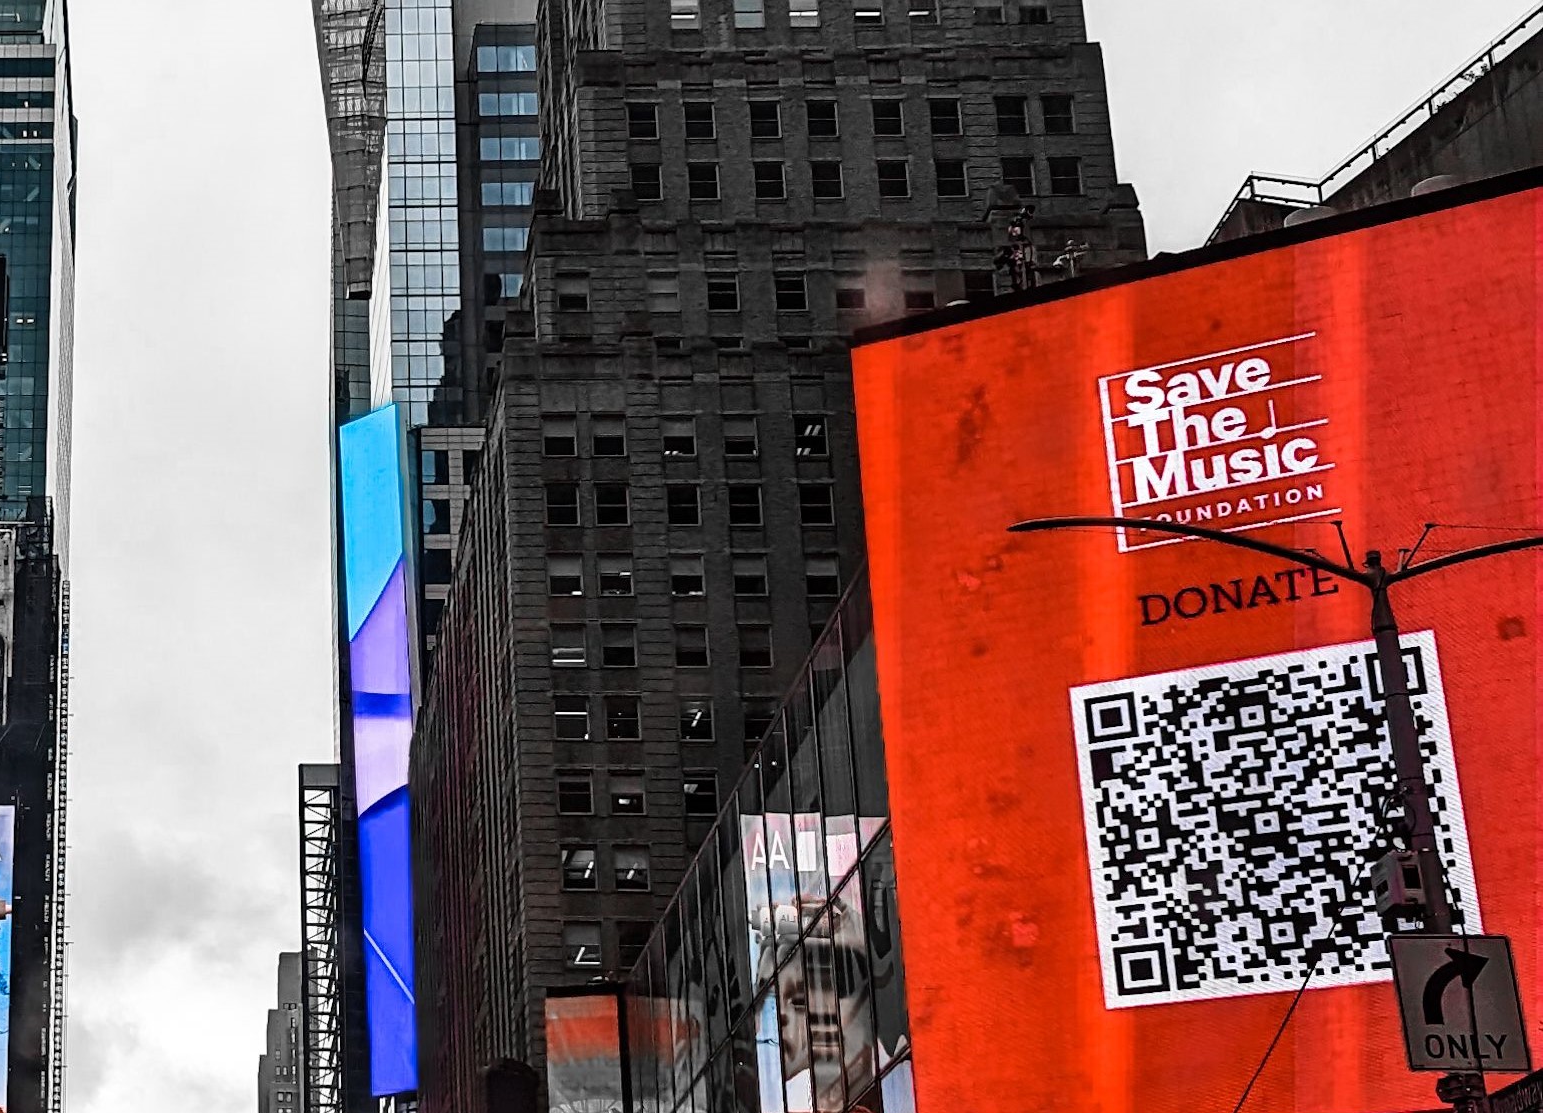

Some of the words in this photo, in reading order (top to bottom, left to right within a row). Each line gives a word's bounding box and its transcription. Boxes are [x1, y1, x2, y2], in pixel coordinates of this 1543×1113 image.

[1124, 356, 1272, 416] Save
[1127, 405, 1248, 458] The
[1131, 437, 1319, 502] Music
[1138, 565, 1340, 627] DONATE
[1425, 1033, 1508, 1060] ONLY
